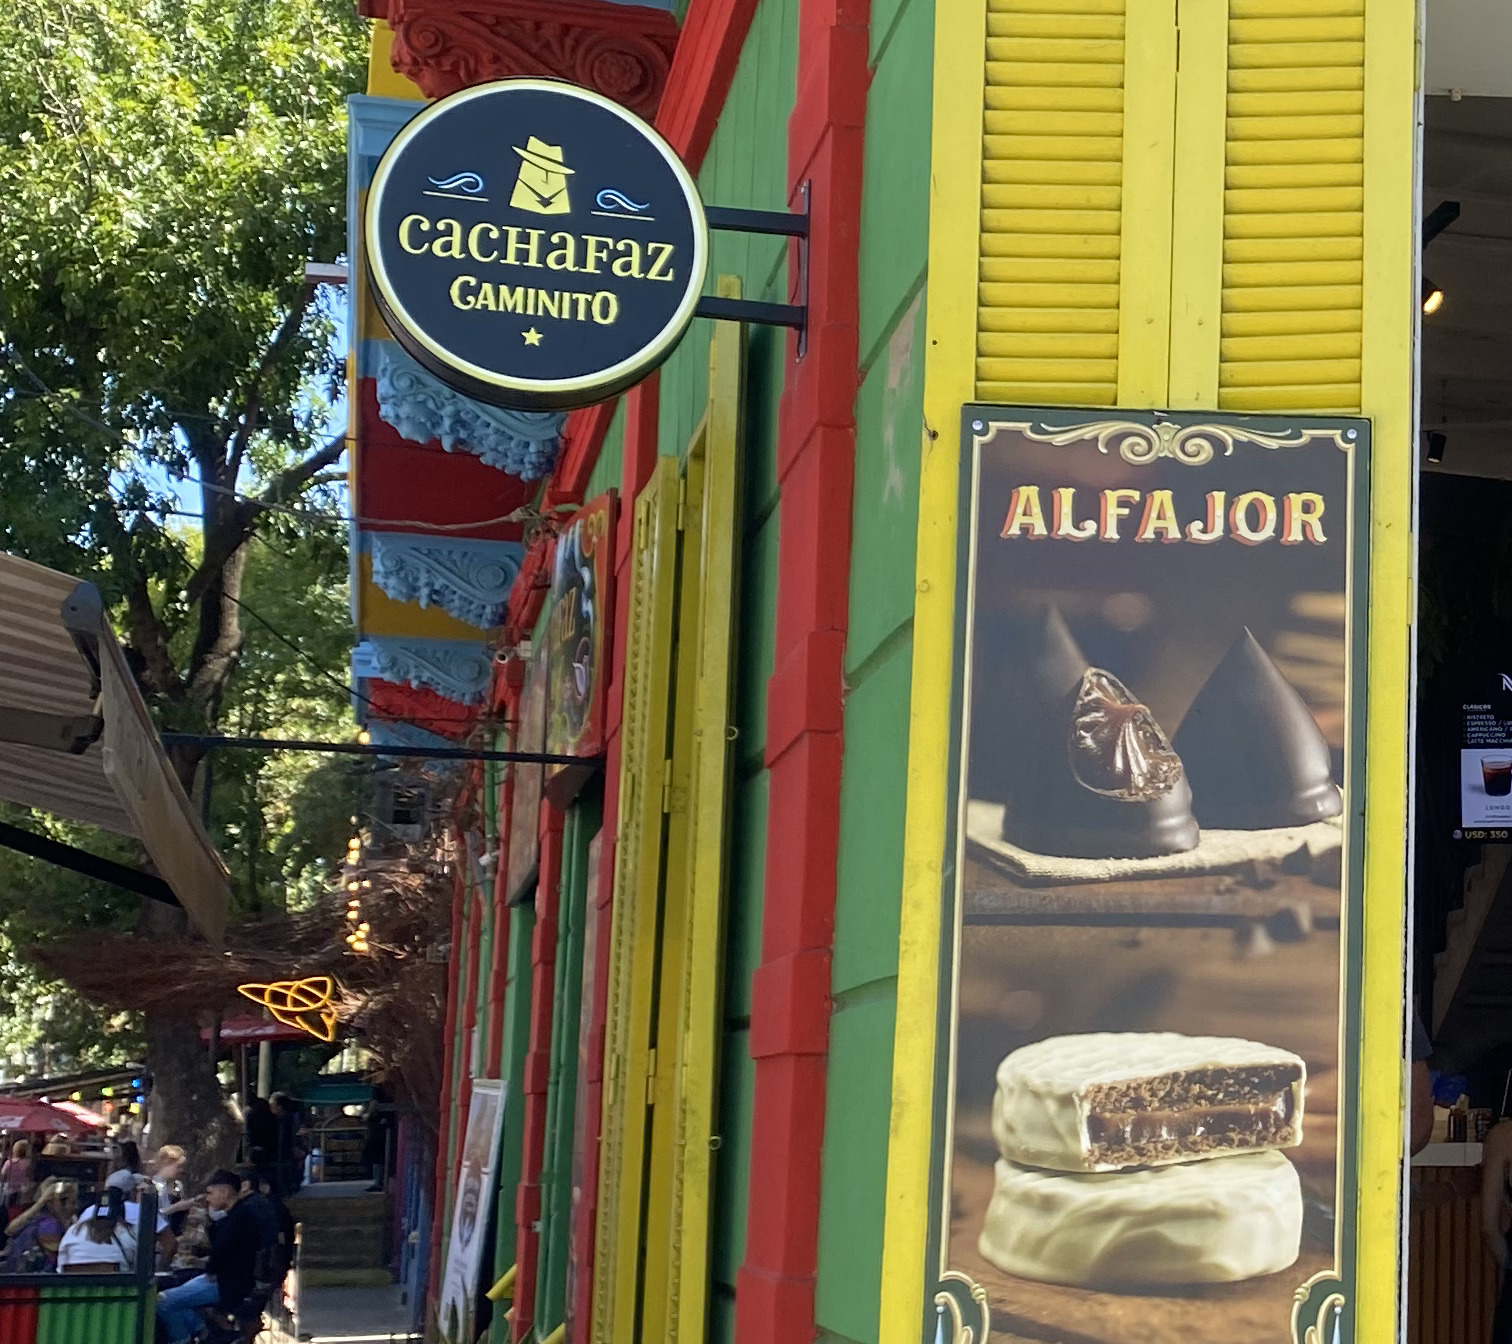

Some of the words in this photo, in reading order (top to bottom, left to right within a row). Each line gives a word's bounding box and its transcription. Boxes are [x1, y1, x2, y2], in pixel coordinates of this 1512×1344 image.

[449, 275, 620, 326] CAMINITO
[1000, 485, 1328, 546] ALFAJOR
[1465, 830, 1488, 839] USD:
[1490, 830, 1508, 839] 350
